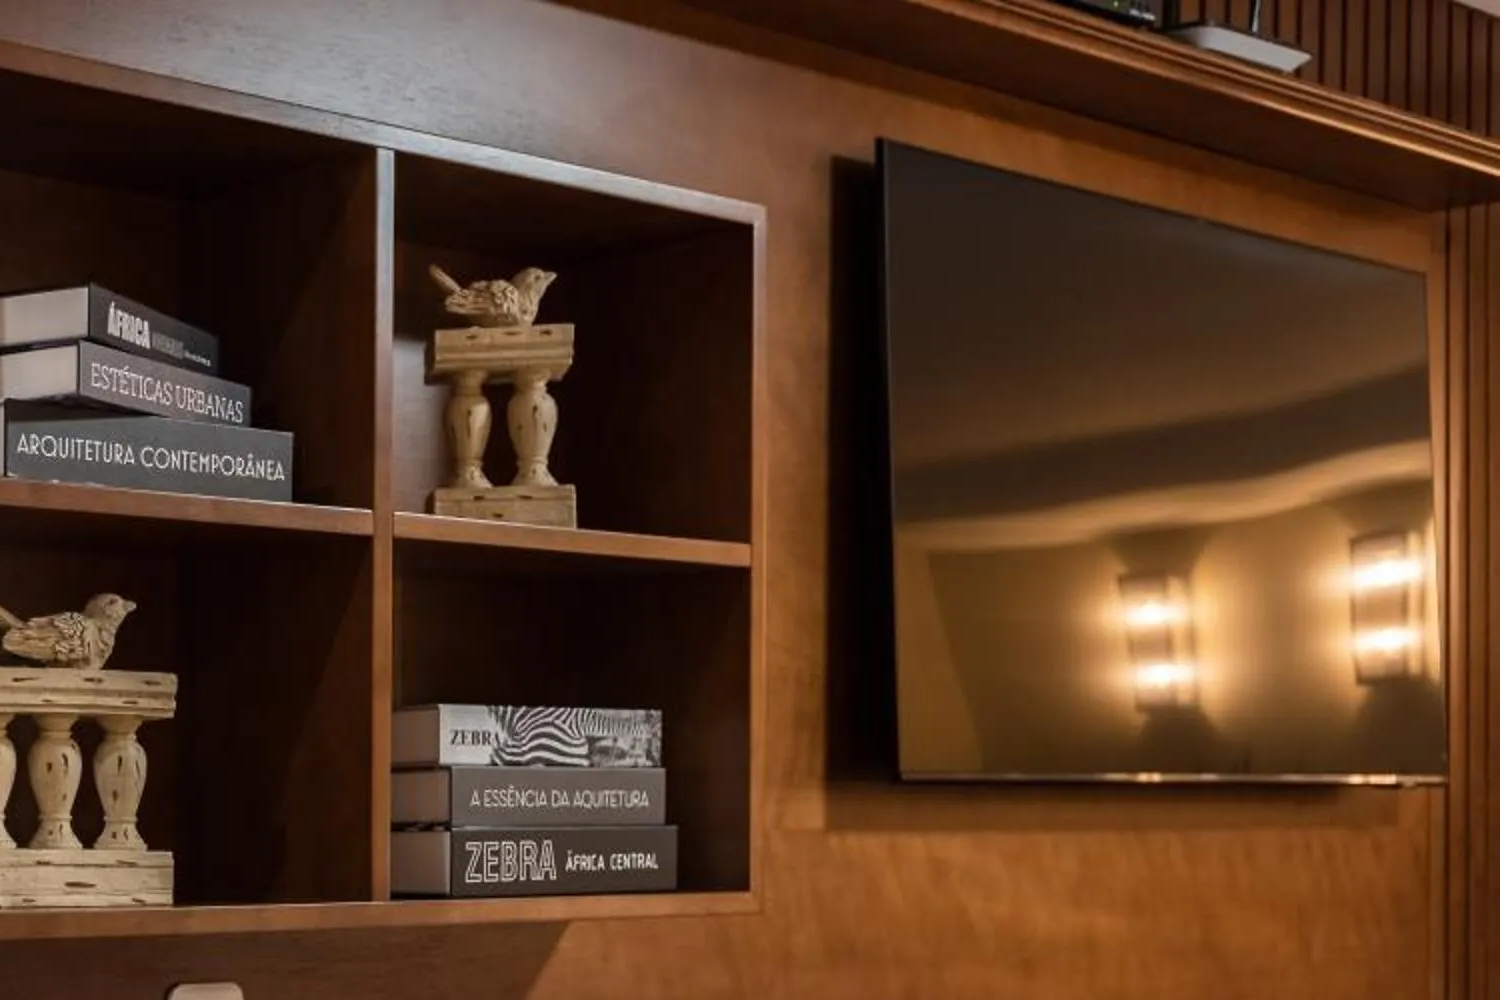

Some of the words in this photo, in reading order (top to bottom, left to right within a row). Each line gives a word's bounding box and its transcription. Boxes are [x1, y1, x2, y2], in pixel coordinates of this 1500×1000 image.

[107, 300, 150, 350] ÁFRICA
[91, 362, 173, 405] ESTÉTICAS
[176, 385, 244, 424] URBANAS
[17, 433, 135, 466] ARQUITETURA
[140, 446, 285, 481] CONTEMPORÂNEA
[469, 789, 481, 807] A
[483, 785, 547, 808] ESSÊNCIA
[551, 789, 570, 808] DA
[573, 789, 649, 809] AQUITETURA
[465, 839, 557, 883] ZEBRA
[565, 850, 605, 872] ÁFRICA
[609, 852, 659, 871] CENTRAL
